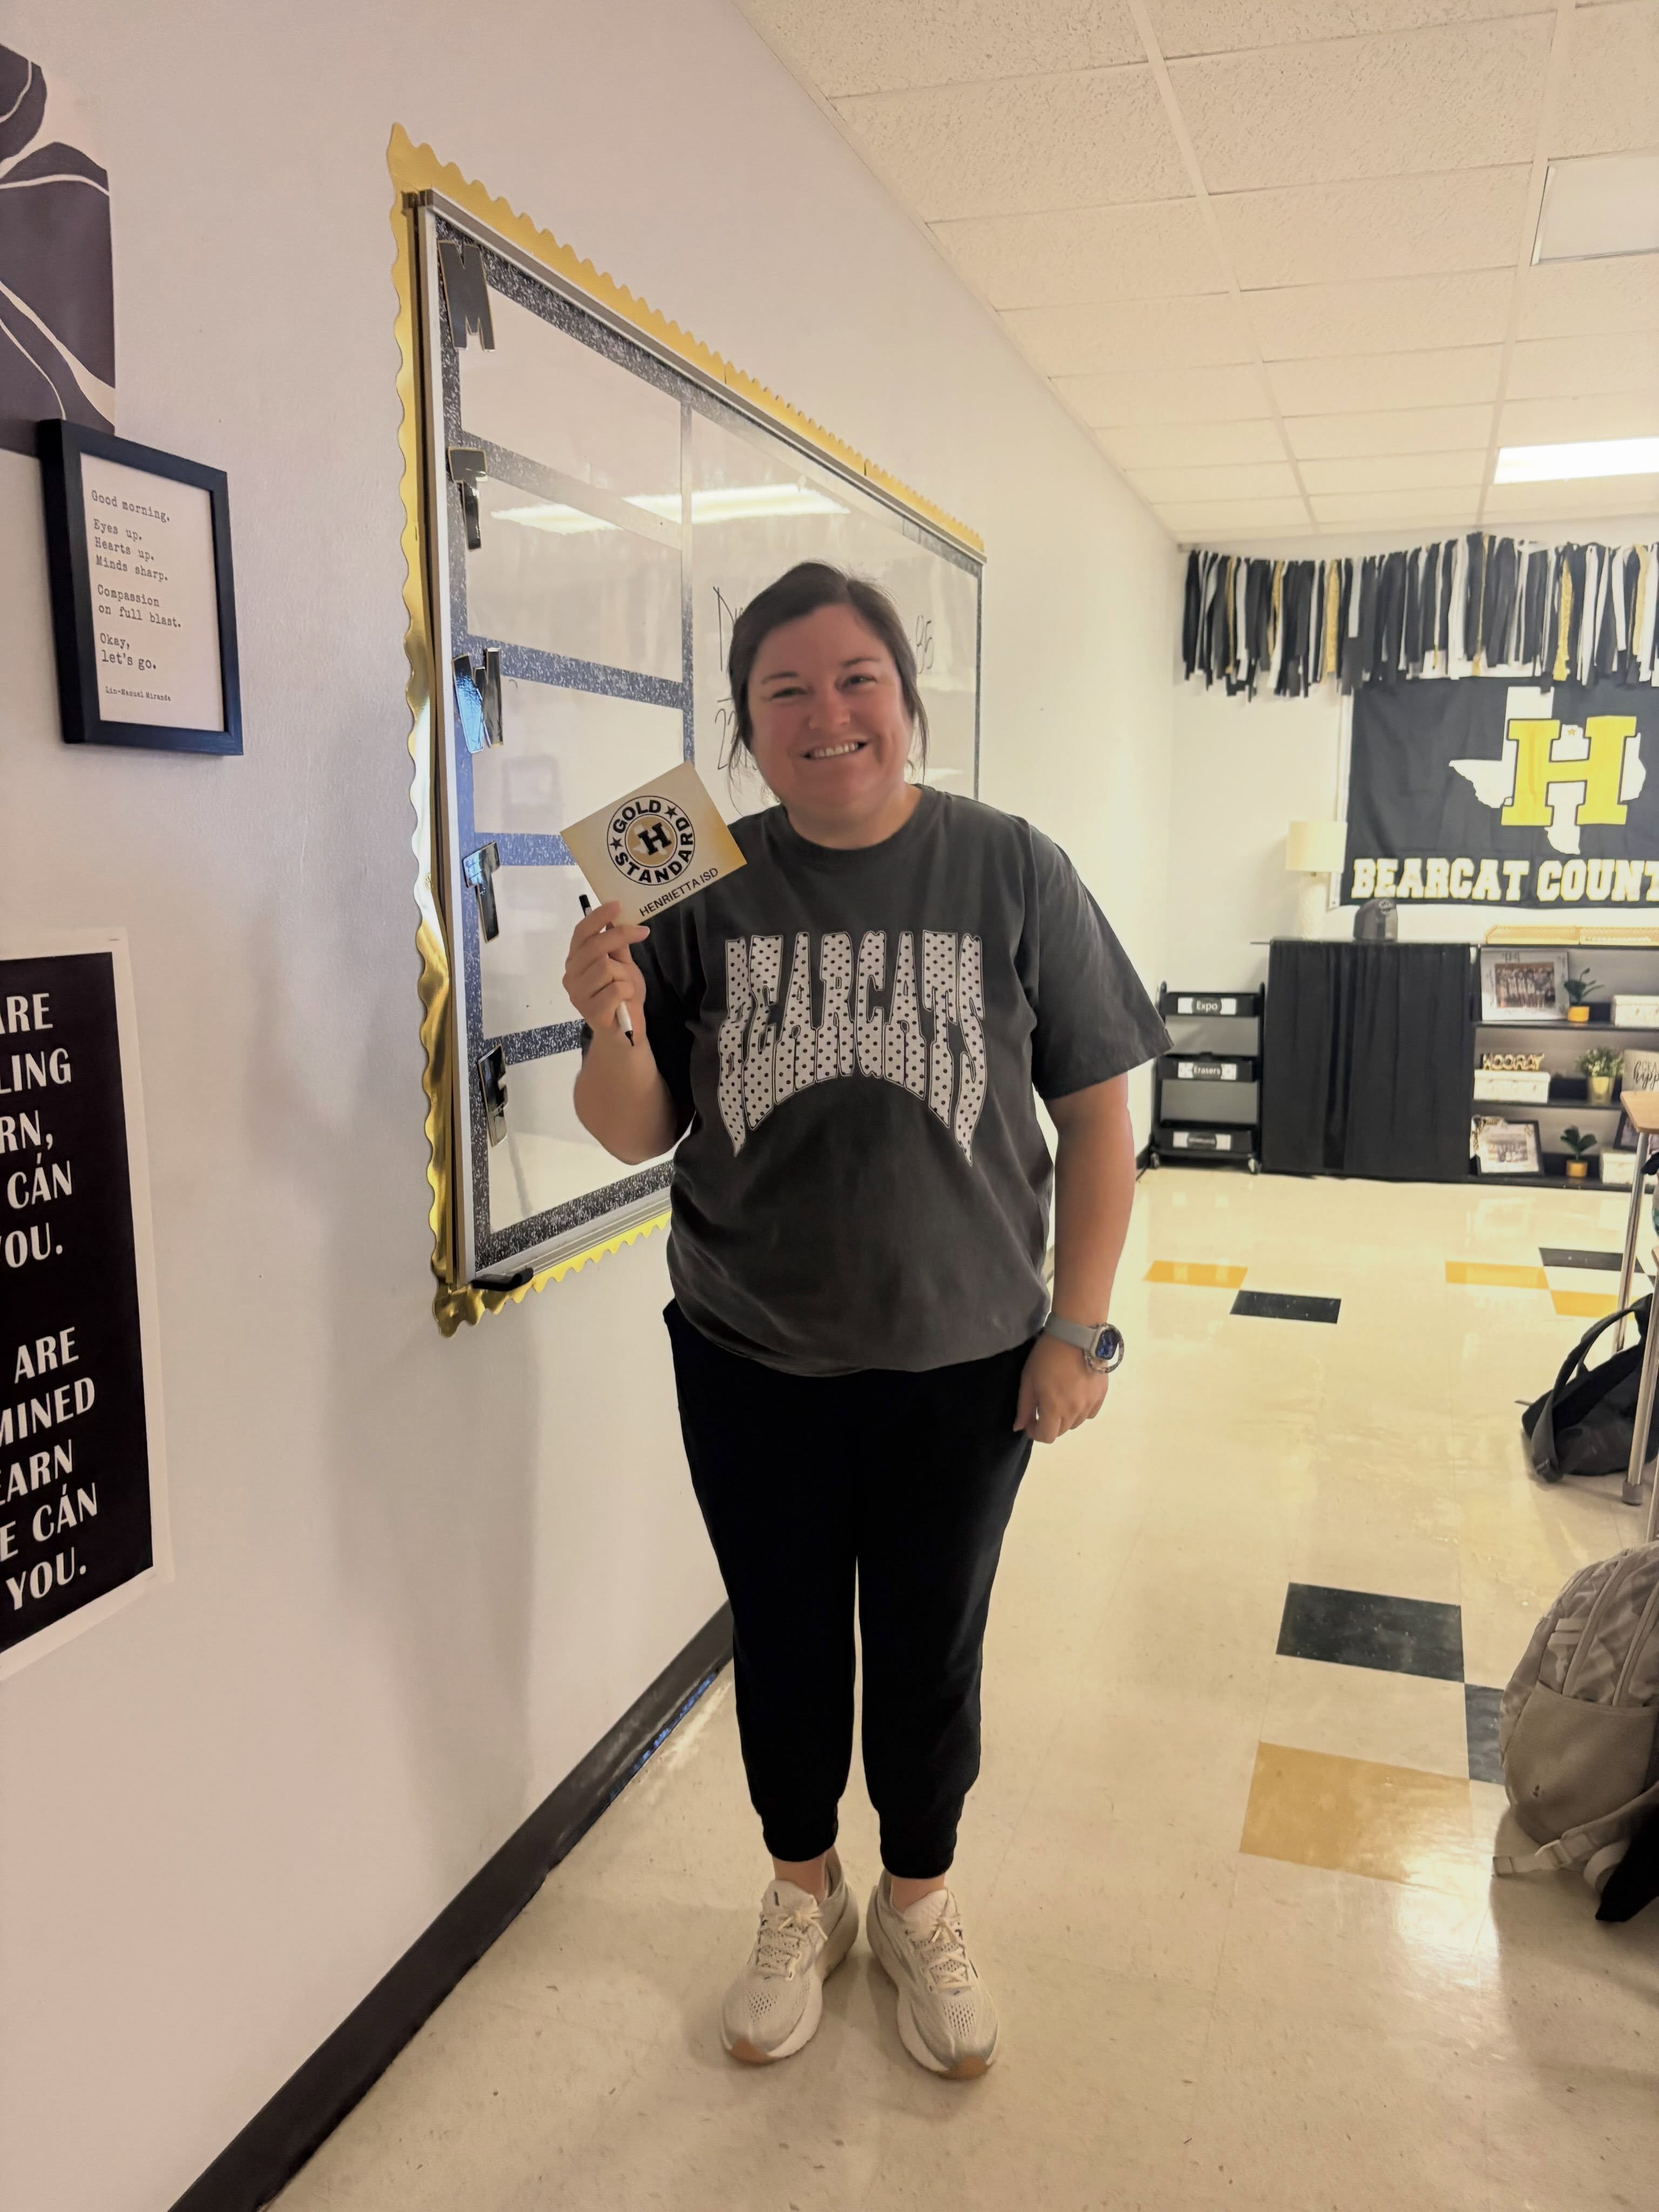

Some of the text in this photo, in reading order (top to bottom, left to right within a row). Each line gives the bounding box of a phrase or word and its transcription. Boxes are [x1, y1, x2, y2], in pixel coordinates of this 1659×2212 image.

[91, 490, 170, 523] Good morning.
[93, 518, 142, 542] Eyes up.
[95, 536, 154, 562] Hearts up.
[96, 554, 168, 582] Minds sharp.
[98, 584, 160, 607] Compassion
[98, 604, 181, 628] on full blast.
[100, 632, 130, 650] Okay,
[102, 649, 157, 670] let's go.
[105, 686, 171, 702] Lin-Manuel Miranda
[612, 799, 662, 833] GOLD
[615, 817, 693, 884] STANDARD
[637, 822, 672, 855] H
[639, 868, 718, 916] HENRIETTA ISD
[1351, 858, 1530, 901] BEARCAT
[1196, 1001, 1218, 1013] Expo
[1193, 1065, 1221, 1075] Erasers
[1481, 1053, 1545, 1071] HOORAY
[0, 1222, 63, 1268] OU.
[15, 1326, 79, 1384] ARE
[5, 1546, 86, 1606] YOU.
